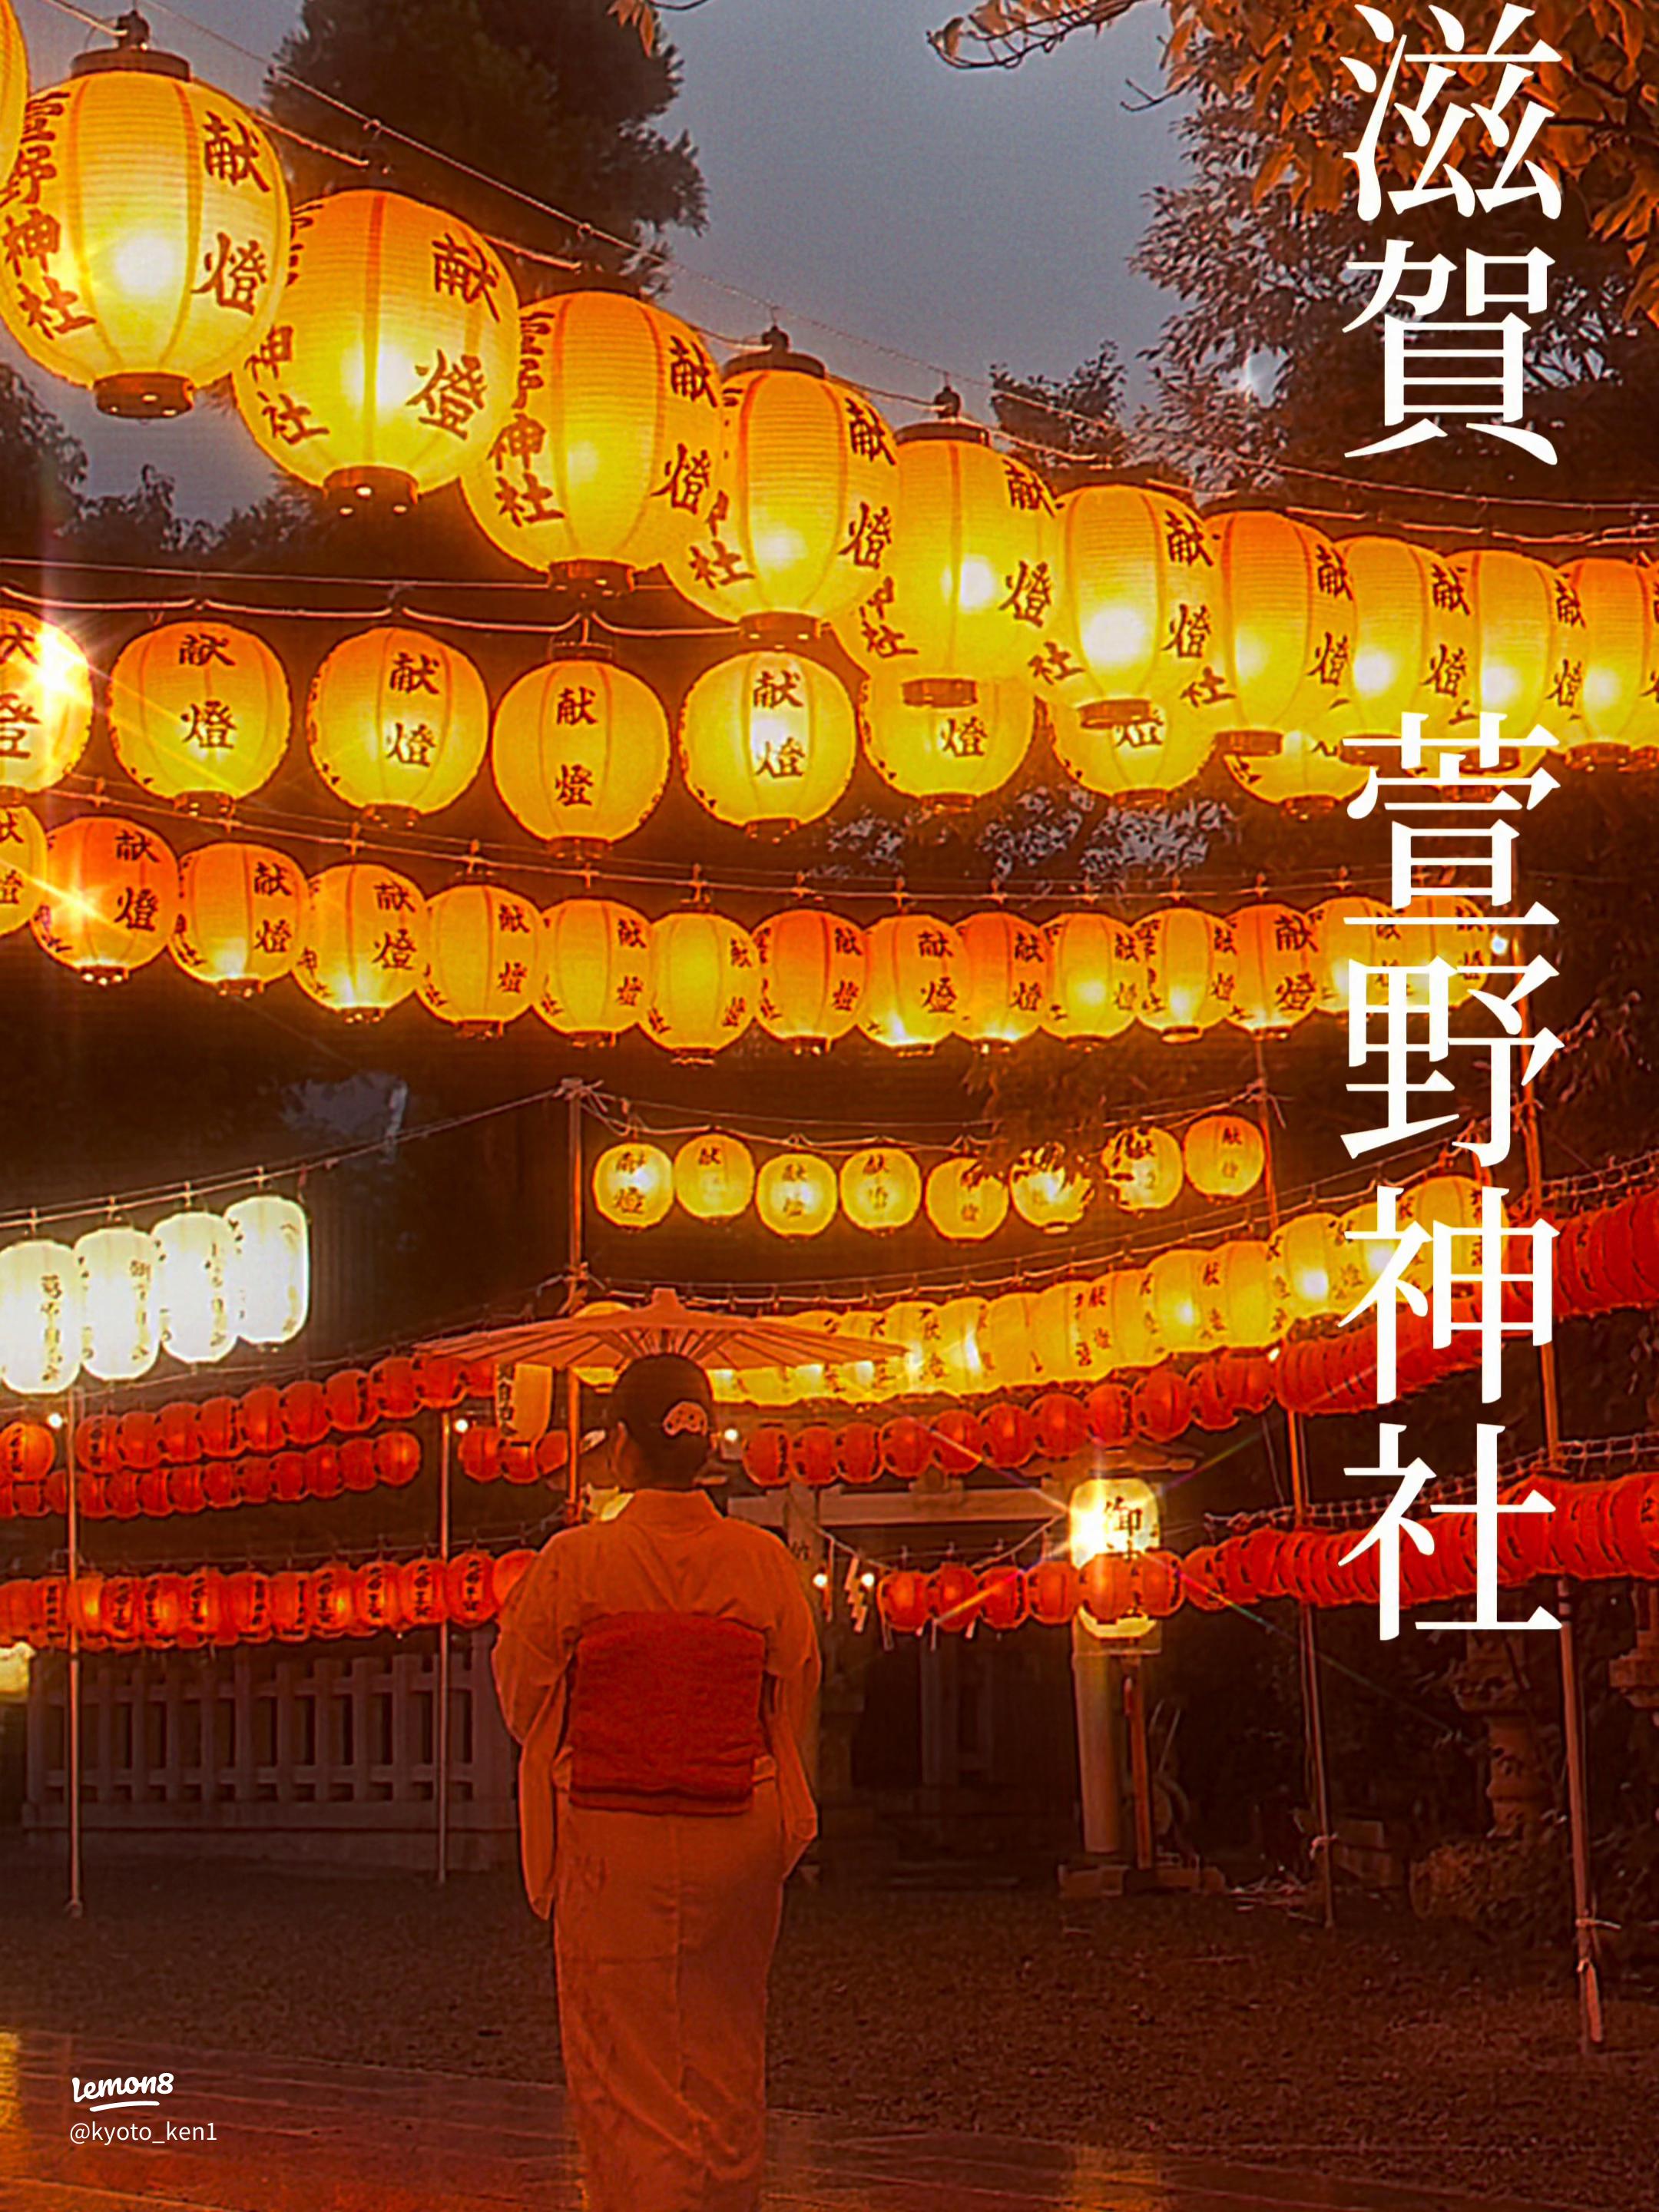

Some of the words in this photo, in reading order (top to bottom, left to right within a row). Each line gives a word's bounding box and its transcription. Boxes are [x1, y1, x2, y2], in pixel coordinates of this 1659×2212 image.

[190, 110, 270, 316] 献燈
[406, 233, 500, 439] 献燈
[651, 336, 718, 515] 献燈
[839, 397, 897, 569] 献燈
[999, 459, 1056, 628] 献燈
[1161, 510, 1214, 660] 献燈
[1308, 544, 1353, 687] 献燈
[1423, 563, 1472, 698] 献燈
[1545, 578, 1586, 707] 献燈
[179, 634, 236, 750] 献燈
[386, 652, 440, 767] 献燈
[555, 687, 599, 807] 献燈
[753, 667, 805, 780] 献燈
[114, 830, 160, 932] 献燈
[253, 862, 292, 954] 献燈
[373, 882, 417, 972] 献燈
[498, 903, 530, 995] 献燈
[617, 919, 647, 1008] 献燈
[723, 938, 753, 1028] 献燈
[833, 927, 862, 1012] 献燈
[918, 930, 958, 1015] 献燈
[1011, 932, 1045, 1012] 献燈
[1114, 932, 1140, 1012] 献燈
[1211, 926, 1238, 1001] 献燈
[1275, 915, 1319, 1011] 献燈
